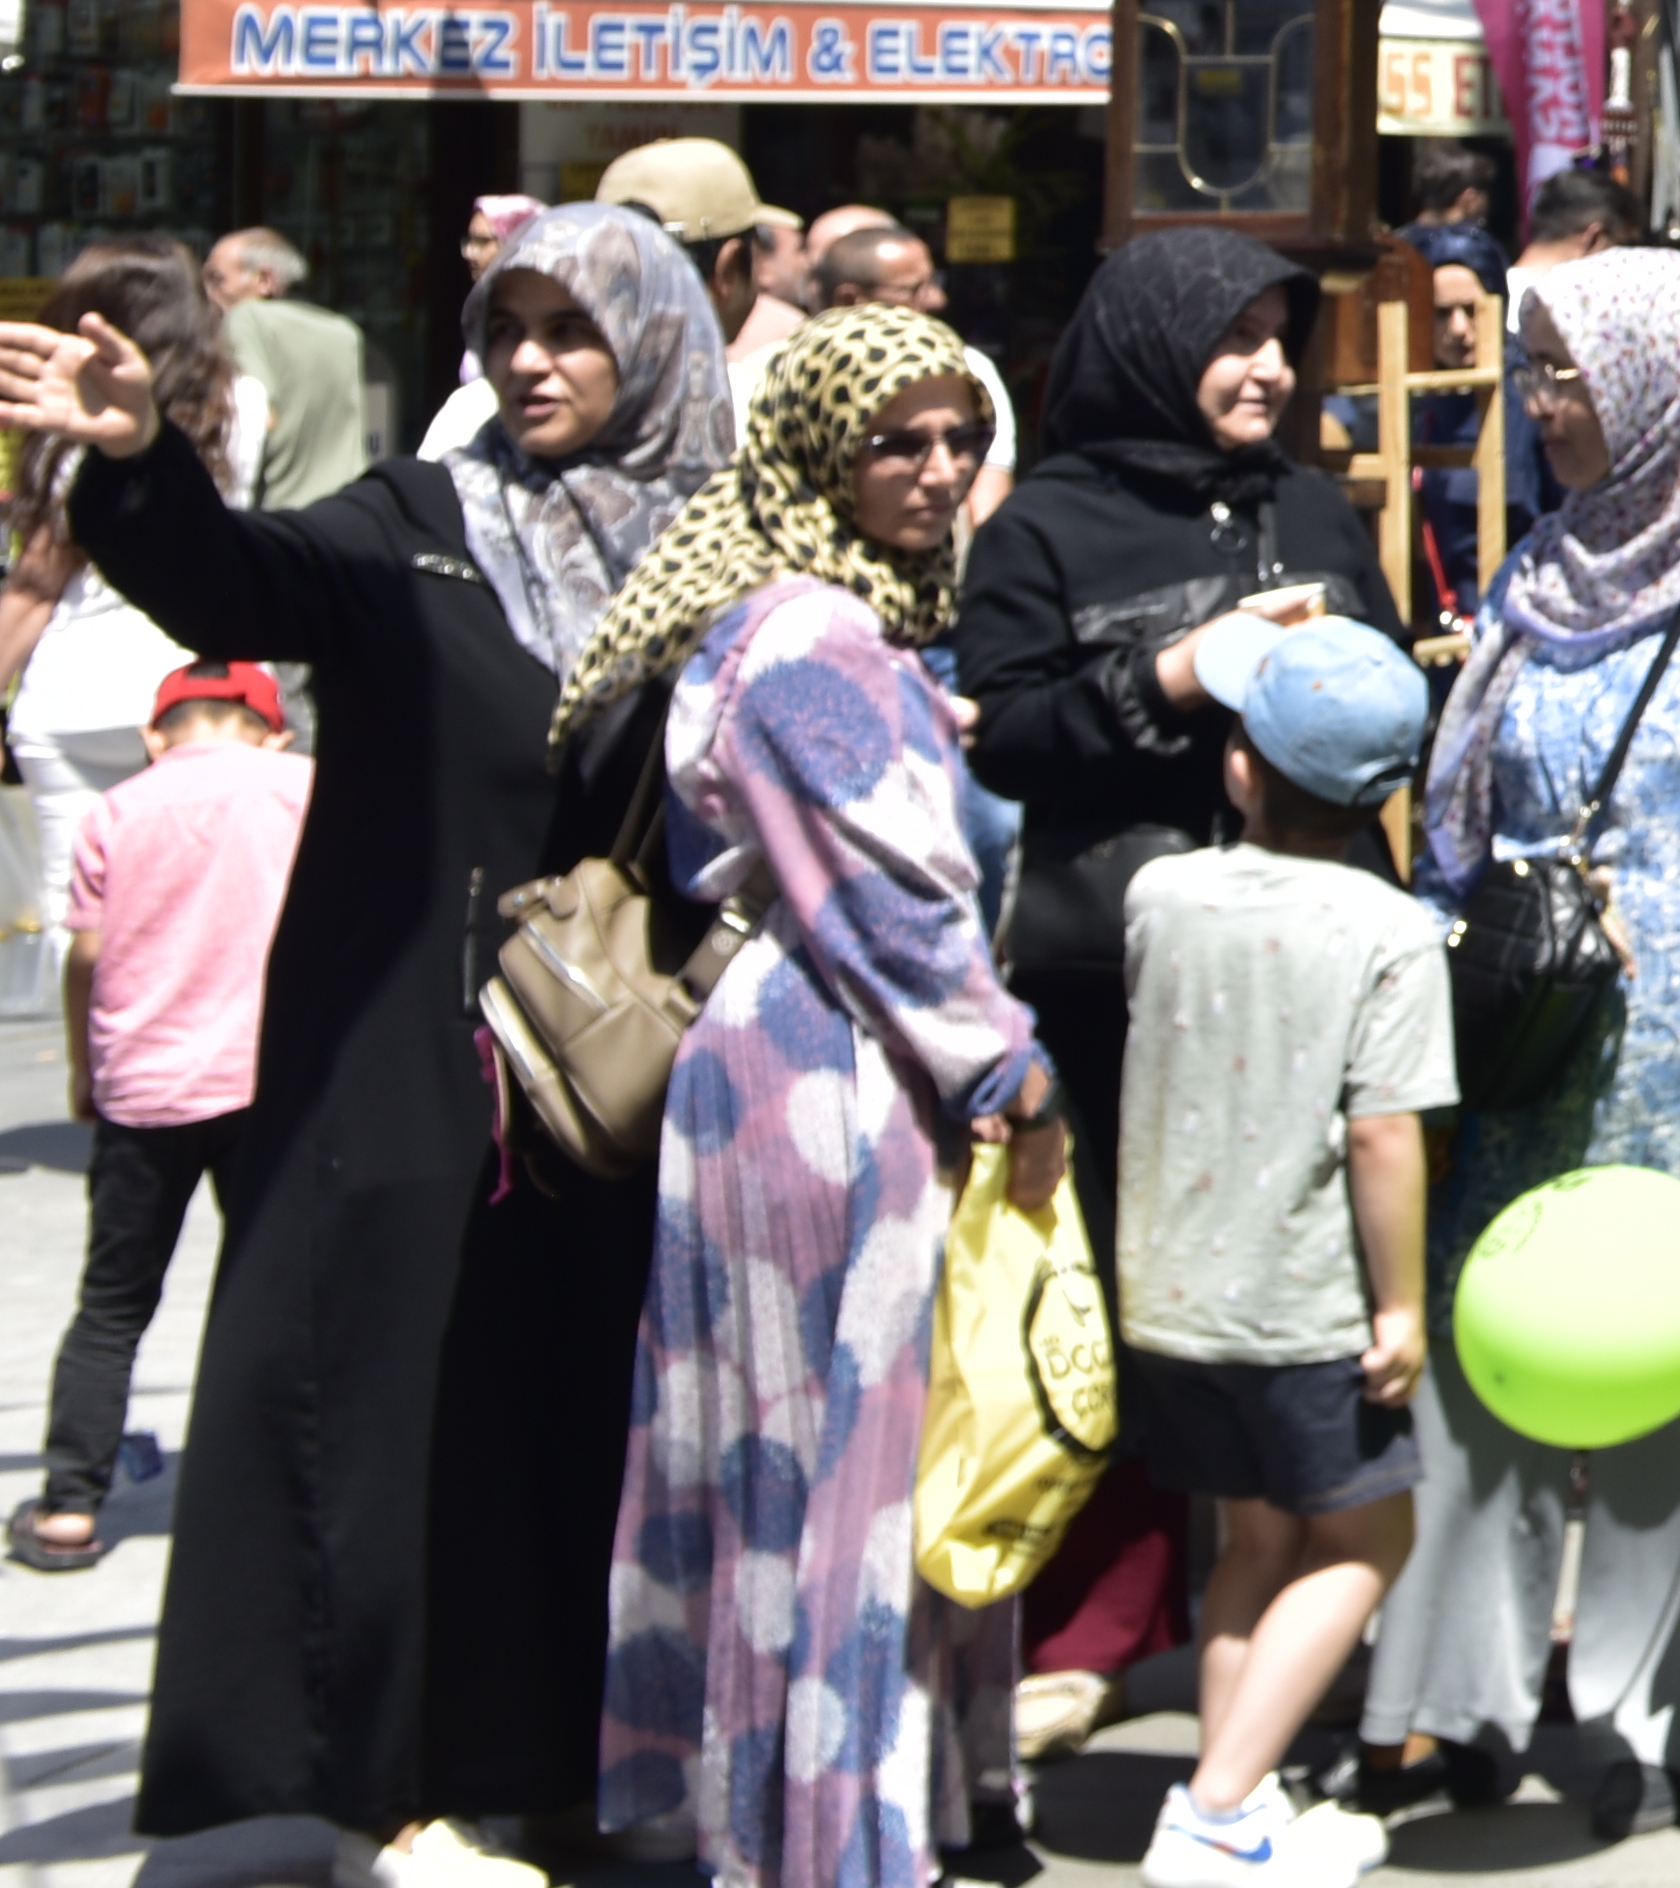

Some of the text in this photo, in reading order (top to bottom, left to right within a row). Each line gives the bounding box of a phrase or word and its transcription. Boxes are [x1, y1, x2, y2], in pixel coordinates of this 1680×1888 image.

[233, 5, 513, 75] MERKEZ
[533, 1, 795, 87] İLETİŞİM
[808, 18, 857, 83] &
